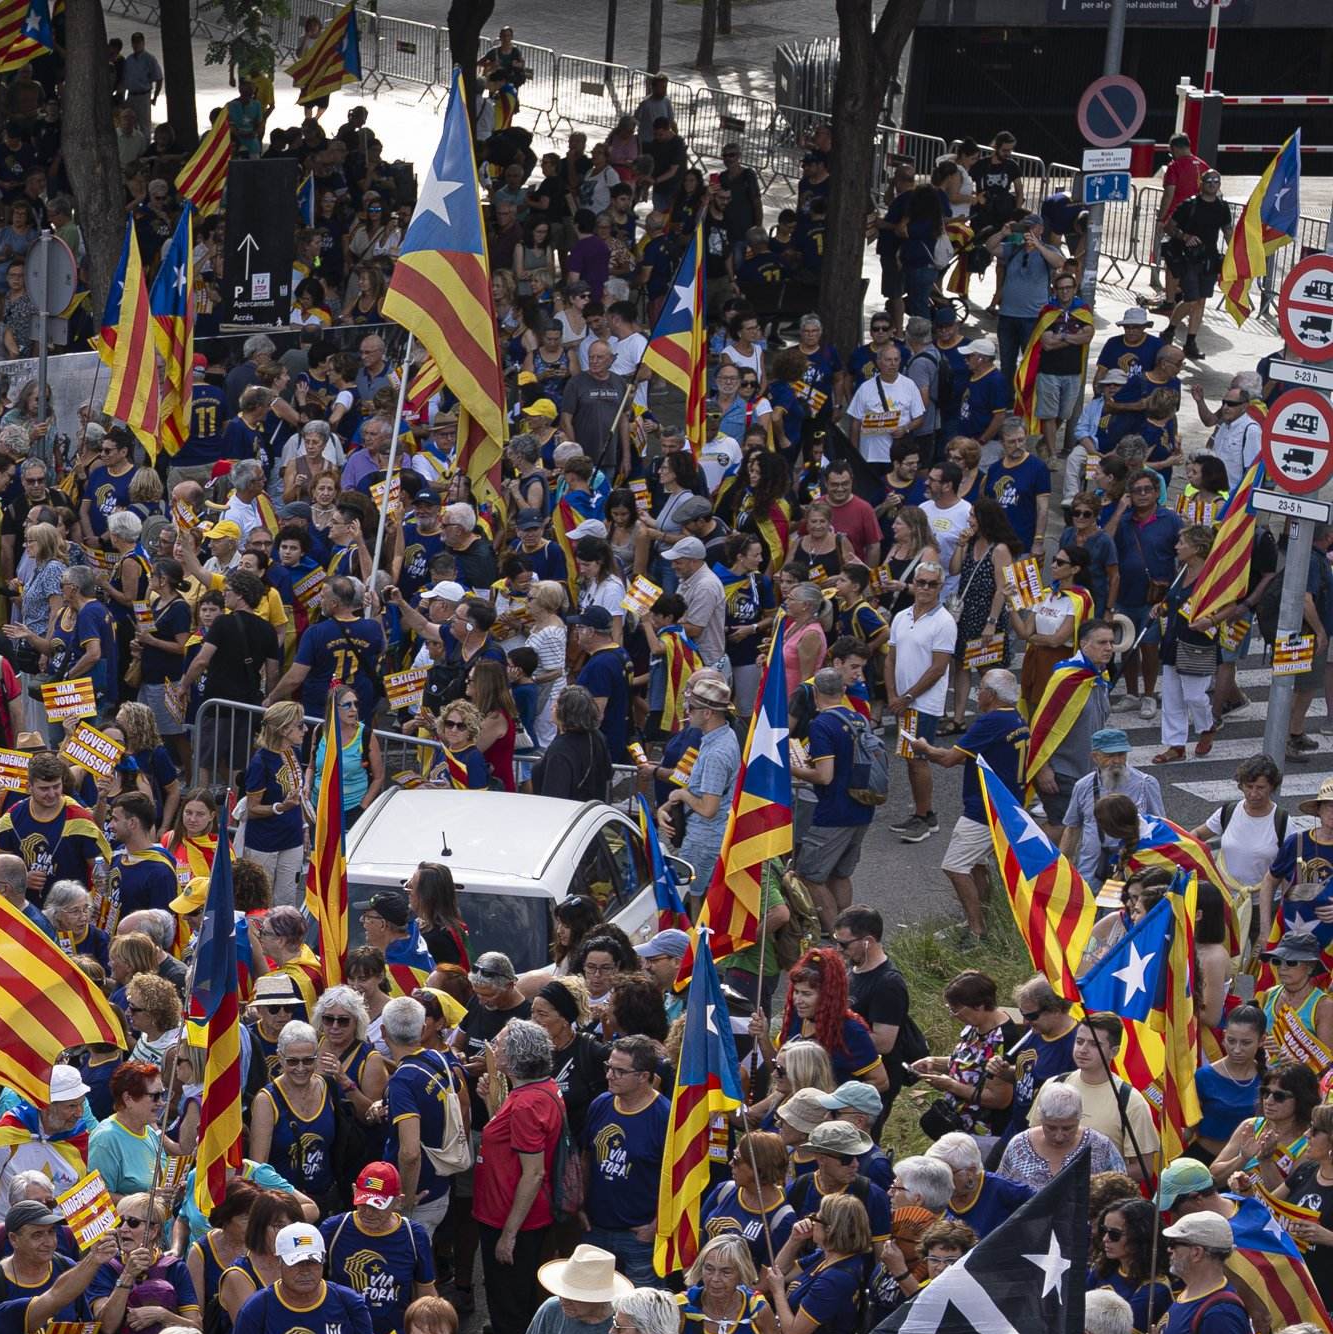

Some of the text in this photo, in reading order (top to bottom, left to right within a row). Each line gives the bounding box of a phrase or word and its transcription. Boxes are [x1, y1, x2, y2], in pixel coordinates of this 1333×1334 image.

[235, 286, 243, 298] P
[1294, 371, 1318, 383] 5-23 h
[1294, 414, 1311, 427] 44
[1279, 500, 1302, 513] 23-5 h
[390, 669, 428, 687] EXIGIM
[55, 684, 73, 693] VAM
[53, 694, 82, 705] VOTAR
[77, 728, 118, 760] GOVERN
[67, 741, 112, 775] DIMISSIÓ
[609, 1146, 627, 1161] VIA
[600, 1160, 632, 1179] FORA!
[370, 1272, 394, 1288] VIA
[363, 1285, 400, 1302] FORA!
